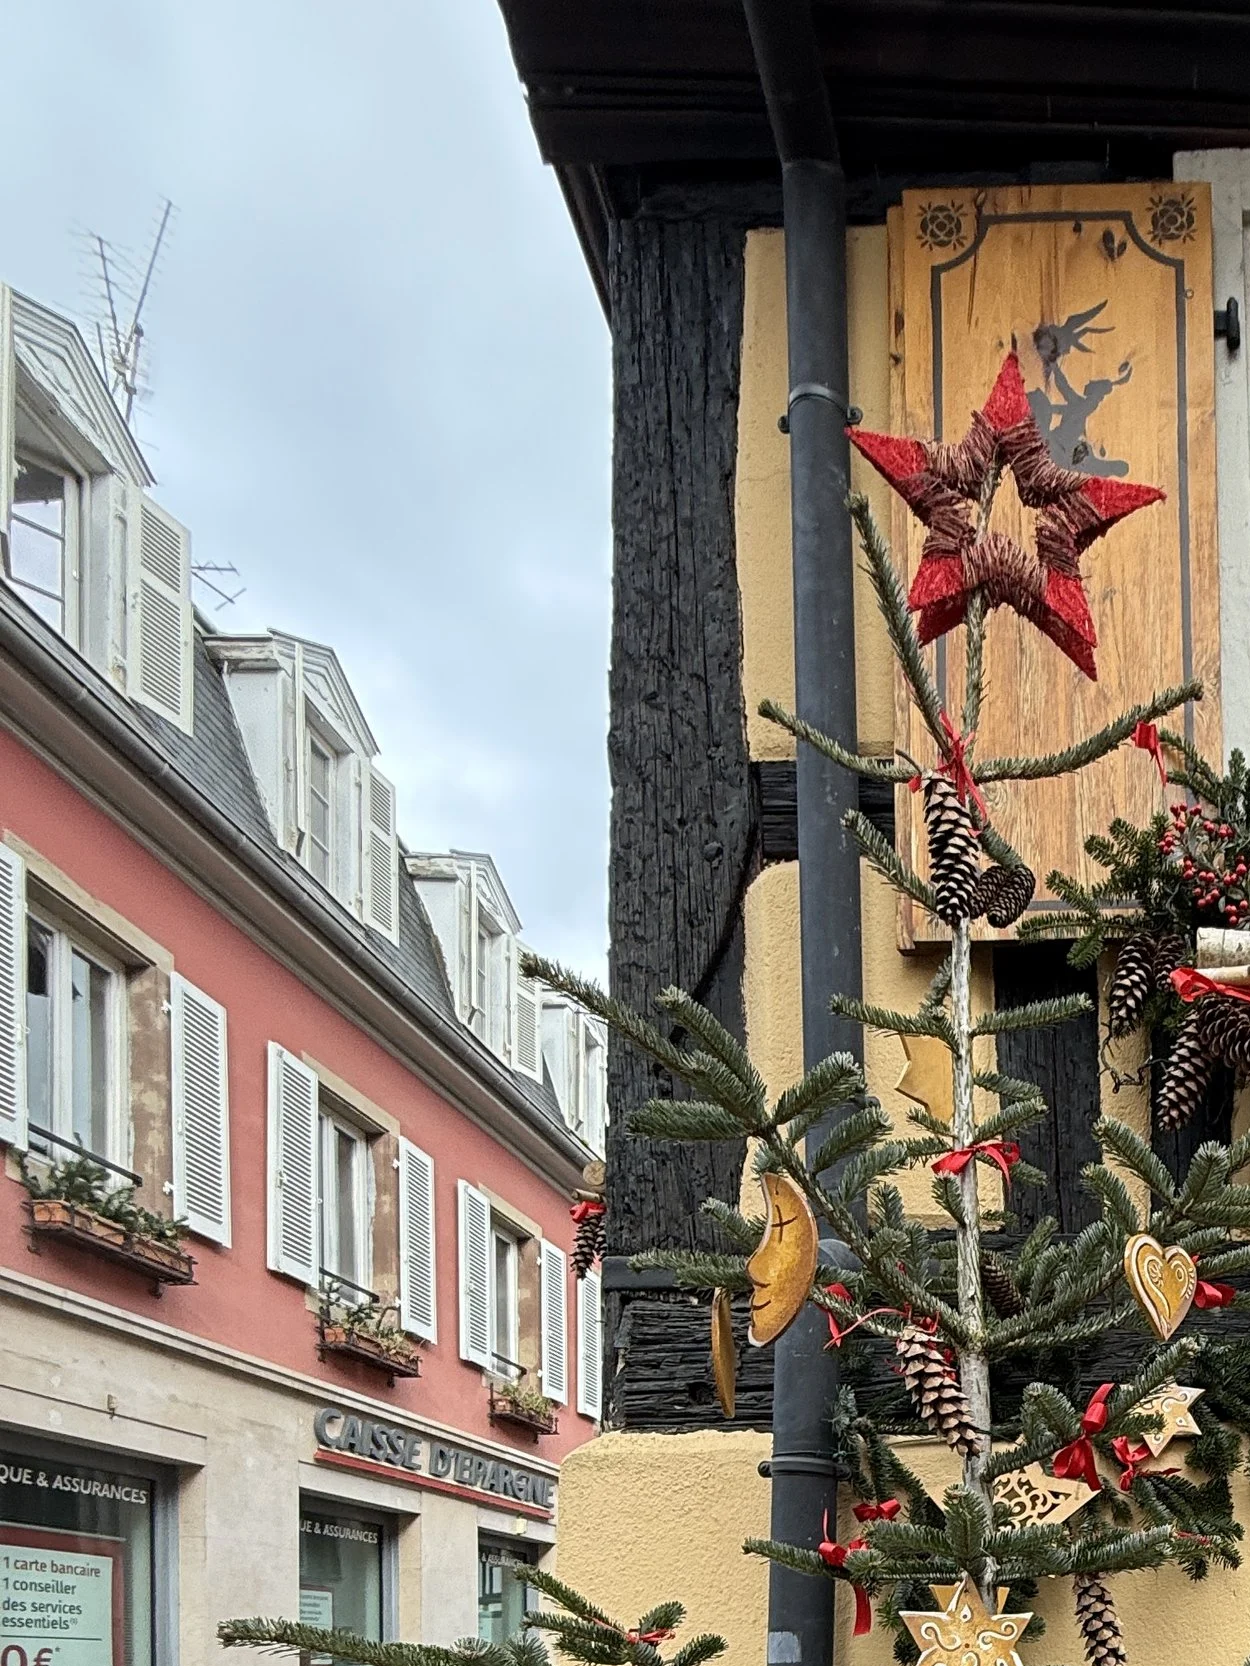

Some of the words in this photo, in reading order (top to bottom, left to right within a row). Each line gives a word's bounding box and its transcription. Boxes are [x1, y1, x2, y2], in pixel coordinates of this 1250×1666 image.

[314, 1407, 422, 1471] CAISSE
[428, 1442, 557, 1508] D'EPARGNE
[36, 1471, 49, 1488] &
[52, 1475, 149, 1504] ASSURANCES
[323, 1524, 379, 1544] ASSURANCES
[3, 1556, 10, 1569] 1
[14, 1559, 47, 1573] carte
[50, 1560, 101, 1578] bancaire
[3, 1577, 9, 1590] 1
[12, 1579, 77, 1594] conseiller
[2, 1597, 27, 1611] des
[30, 1600, 82, 1615] services
